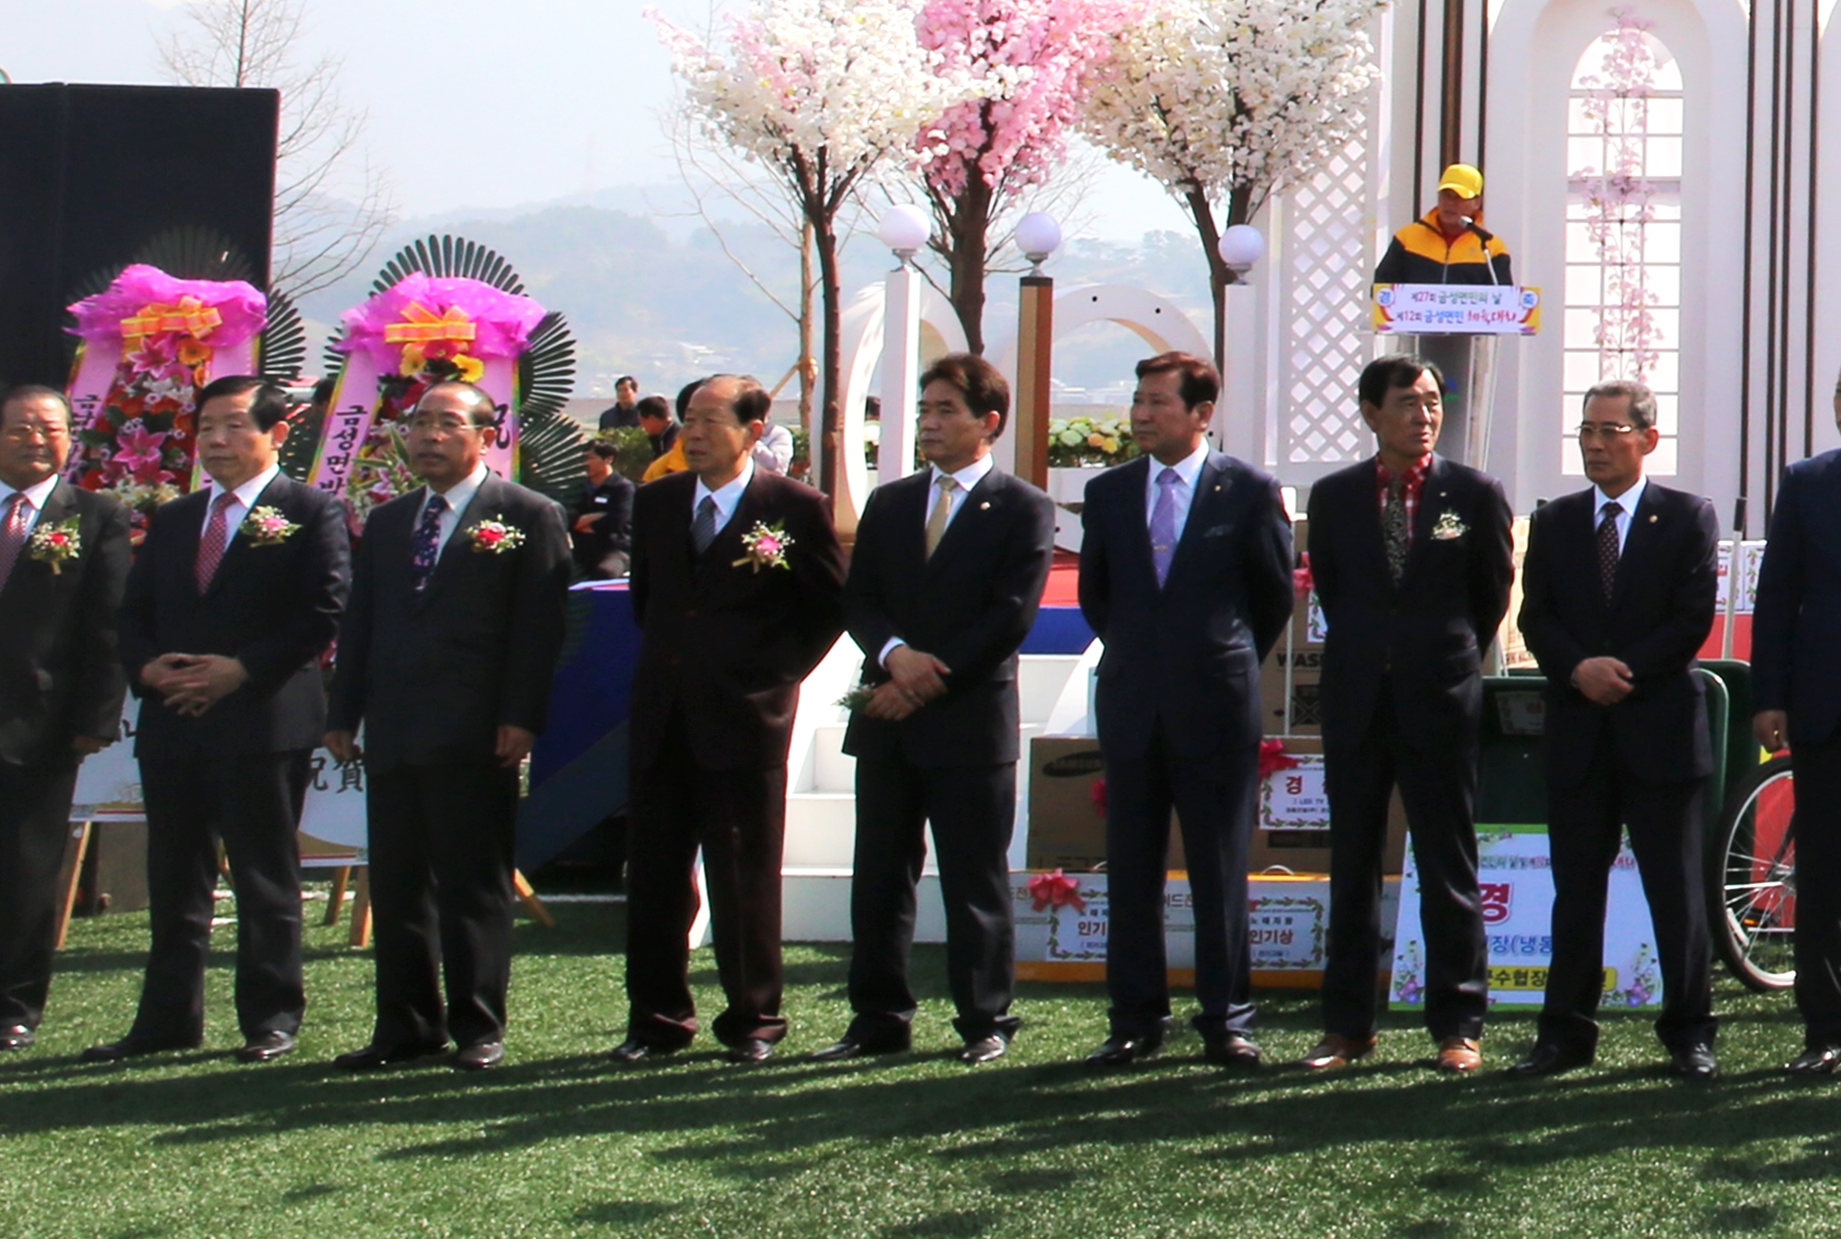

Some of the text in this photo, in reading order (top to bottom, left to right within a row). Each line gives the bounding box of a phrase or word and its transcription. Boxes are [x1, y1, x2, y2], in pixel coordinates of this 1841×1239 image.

[1276, 651, 1323, 668] WAS
[1077, 921, 1107, 936] 인기
[1249, 929, 1294, 945] 인기상
[1488, 935, 1552, 955] 장(냉동
